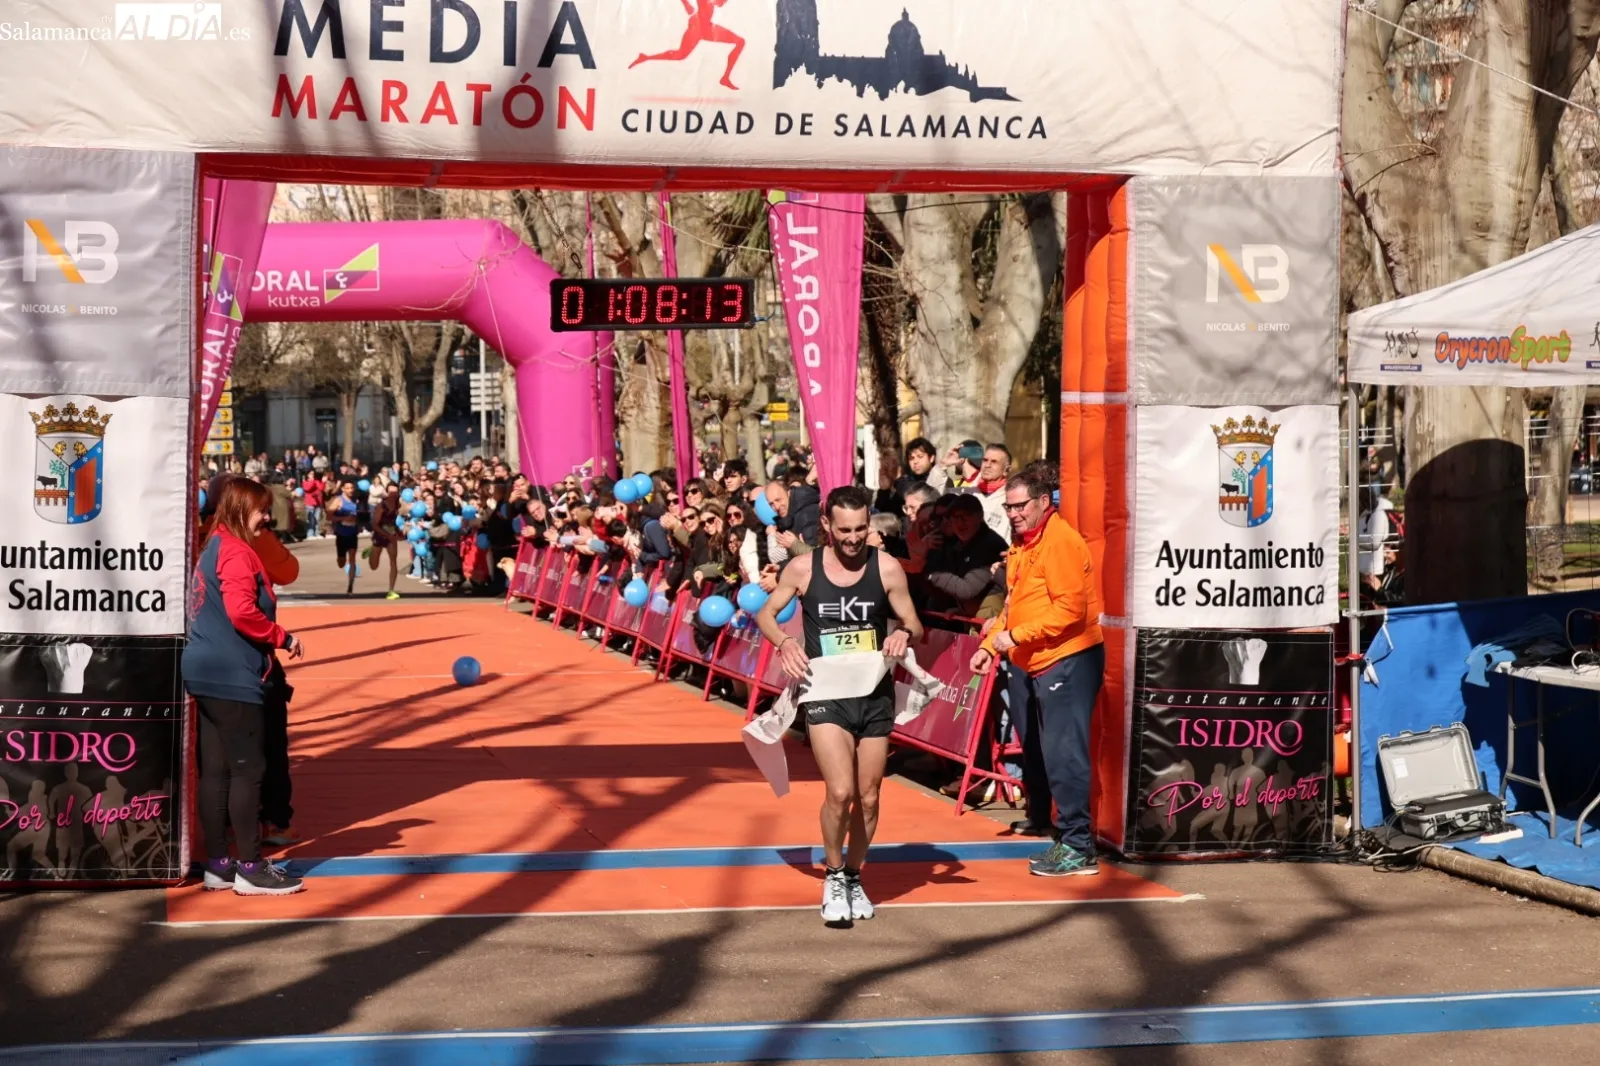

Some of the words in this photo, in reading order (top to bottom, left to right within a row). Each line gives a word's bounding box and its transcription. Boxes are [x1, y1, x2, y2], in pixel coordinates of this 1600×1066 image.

[274, 0, 597, 69] MEDIA
[271, 72, 596, 131] MARATÓN
[621, 108, 755, 135] CIUDAD
[774, 112, 813, 136] DE
[833, 113, 1048, 139] SALAMANCA
[21, 303, 66, 314] NICOLAS
[80, 305, 118, 316] BENITO
[267, 294, 321, 308] kutxa
[1206, 322, 1246, 332] NICOLAS
[1258, 323, 1290, 332] BENITO
[1155, 540, 1325, 576] Ayuntamiento
[8, 579, 166, 612] Salamanca
[818, 596, 875, 621] EKT
[1155, 578, 1186, 606] de
[1195, 578, 1325, 608] Salamanca
[835, 633, 860, 645] 721
[1149, 692, 1328, 706] restaurante
[0, 730, 138, 772] SIDRO
[1177, 718, 1304, 756] ISIDRO
[57, 794, 74, 827] el
[84, 792, 170, 838] deporte
[1147, 780, 1228, 829] Por
[1235, 776, 1252, 807] el
[1257, 774, 1327, 816] deporte
